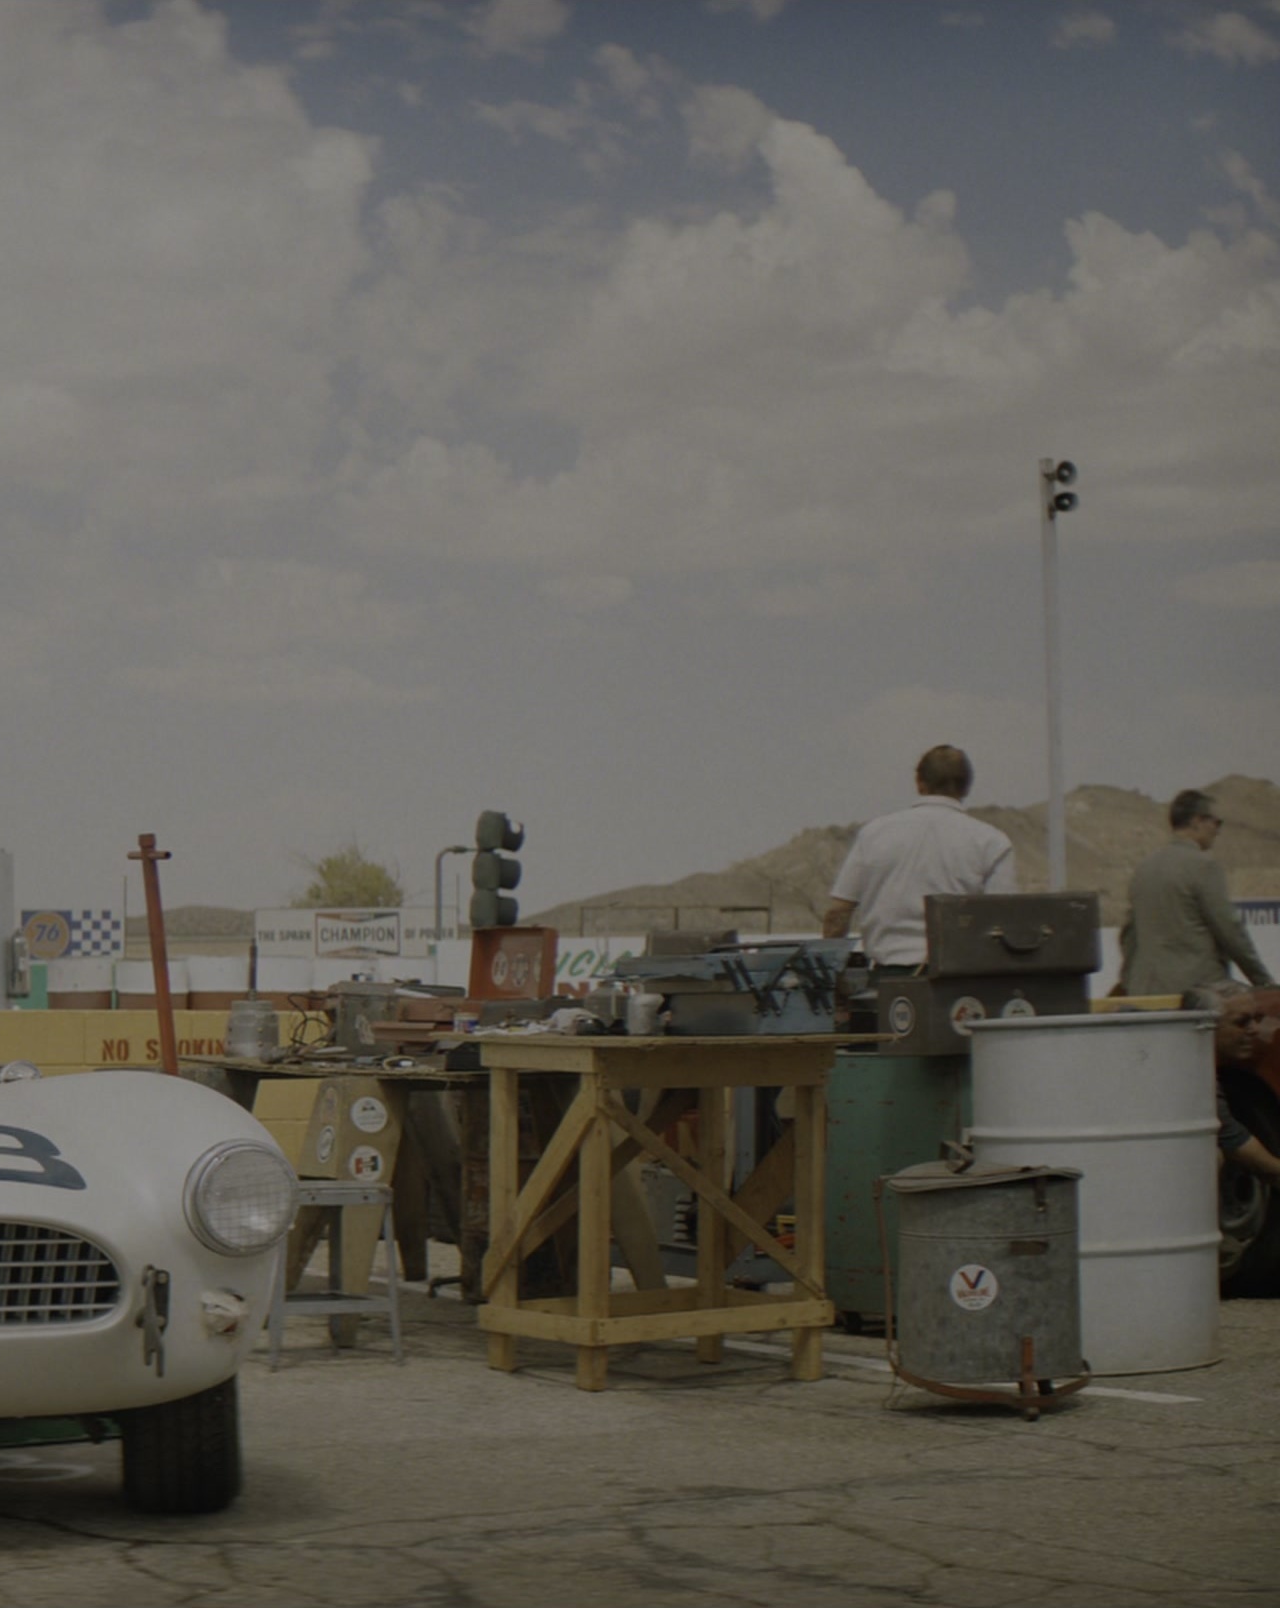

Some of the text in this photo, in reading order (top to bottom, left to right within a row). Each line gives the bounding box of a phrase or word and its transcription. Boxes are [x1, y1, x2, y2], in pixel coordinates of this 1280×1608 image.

[35, 922, 61, 944] 76
[257, 928, 276, 942] THE
[279, 928, 312, 942] SPARK
[320, 926, 396, 943] CHAMPION
[101, 1037, 226, 1062] NO SOKIN
